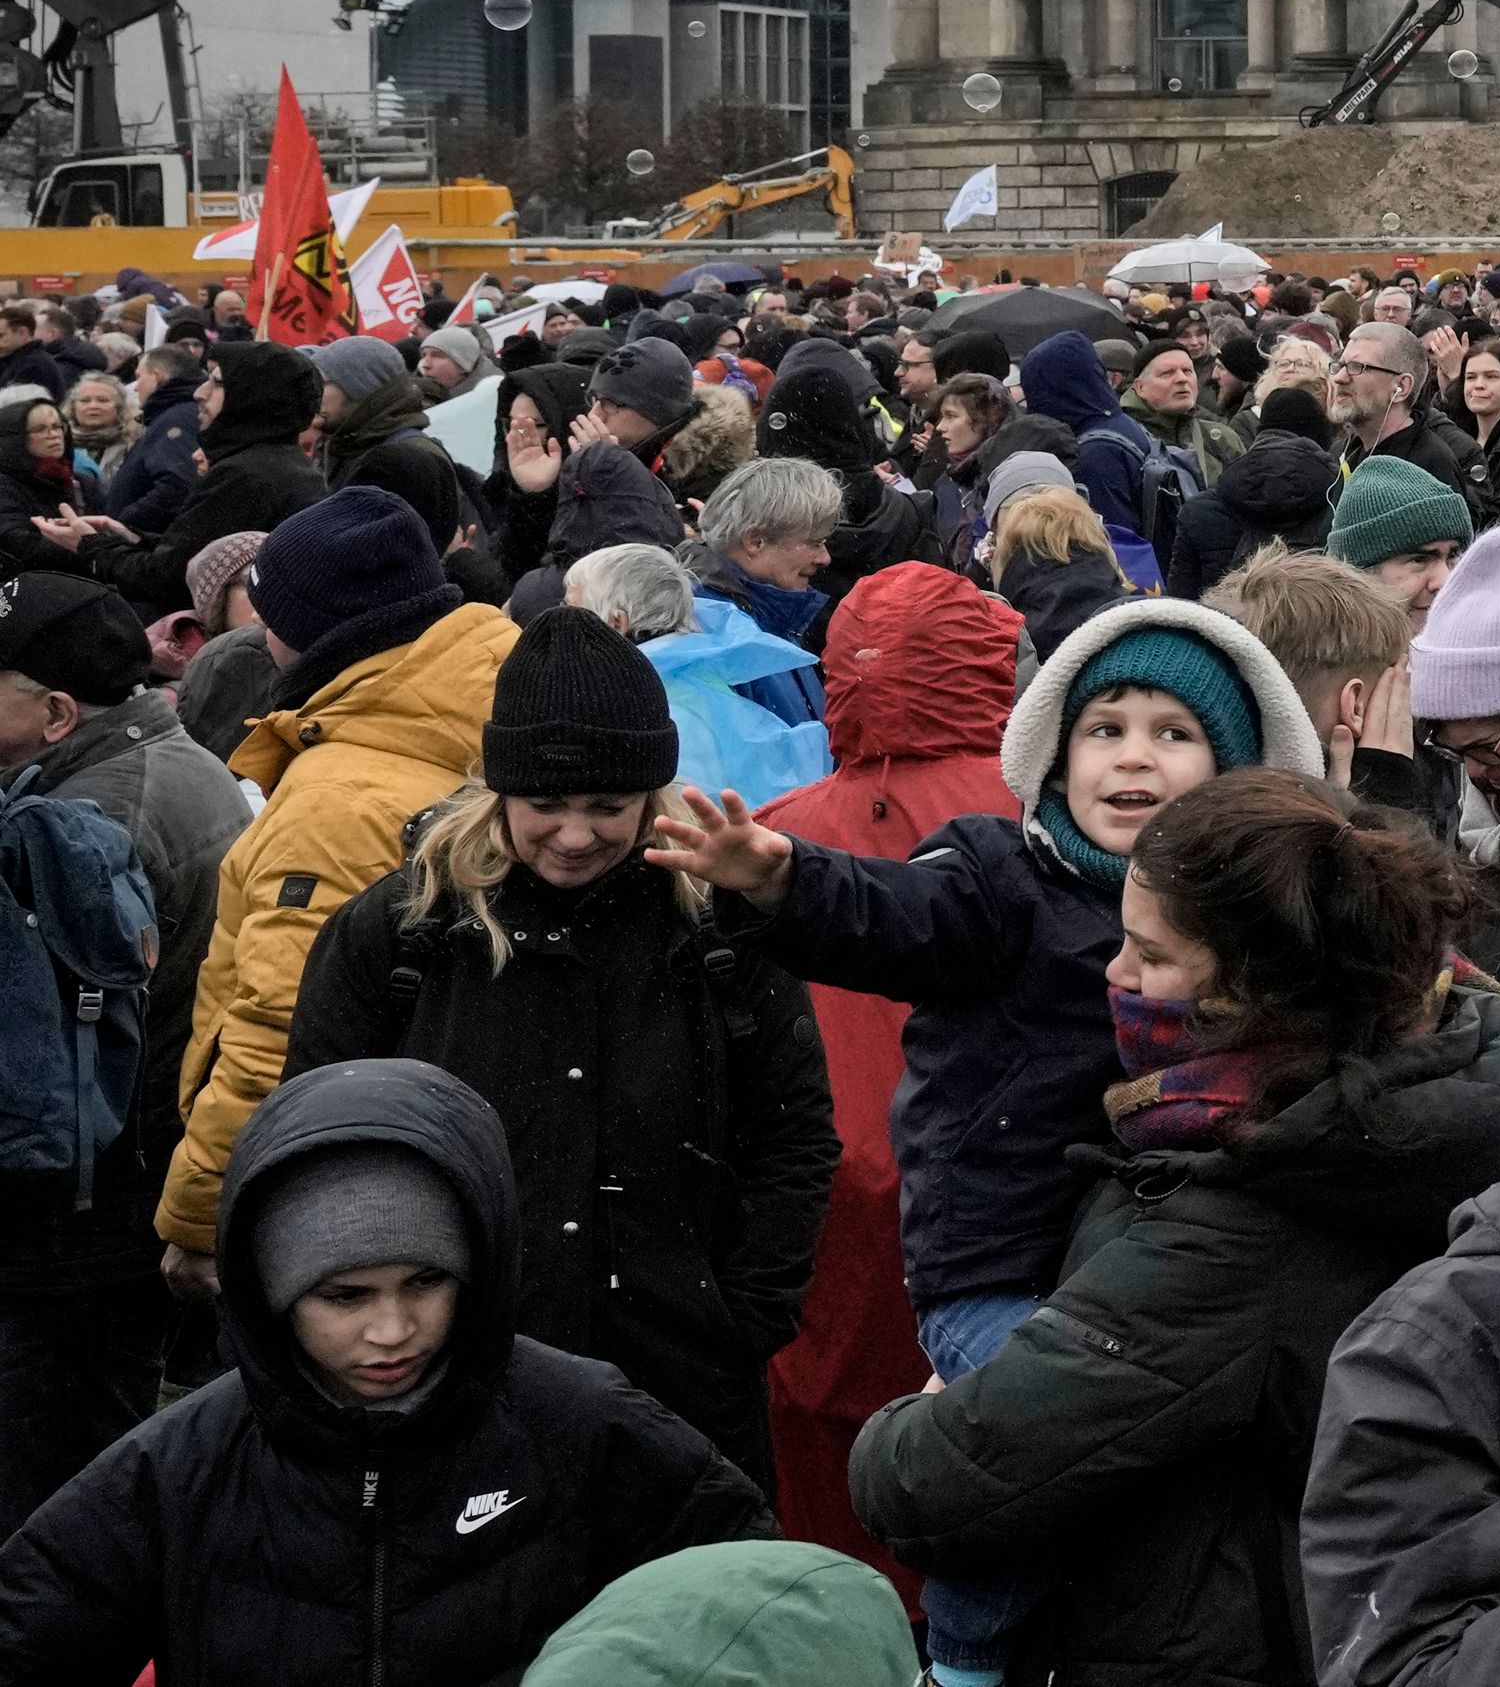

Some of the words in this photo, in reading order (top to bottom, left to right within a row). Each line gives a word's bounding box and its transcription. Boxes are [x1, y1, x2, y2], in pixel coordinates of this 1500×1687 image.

[1393, 40, 1413, 64] ATLAS
[1343, 81, 1376, 115] MIETPARK
[363, 1471, 379, 1507] NIKE
[464, 1489, 509, 1518] NIKE
